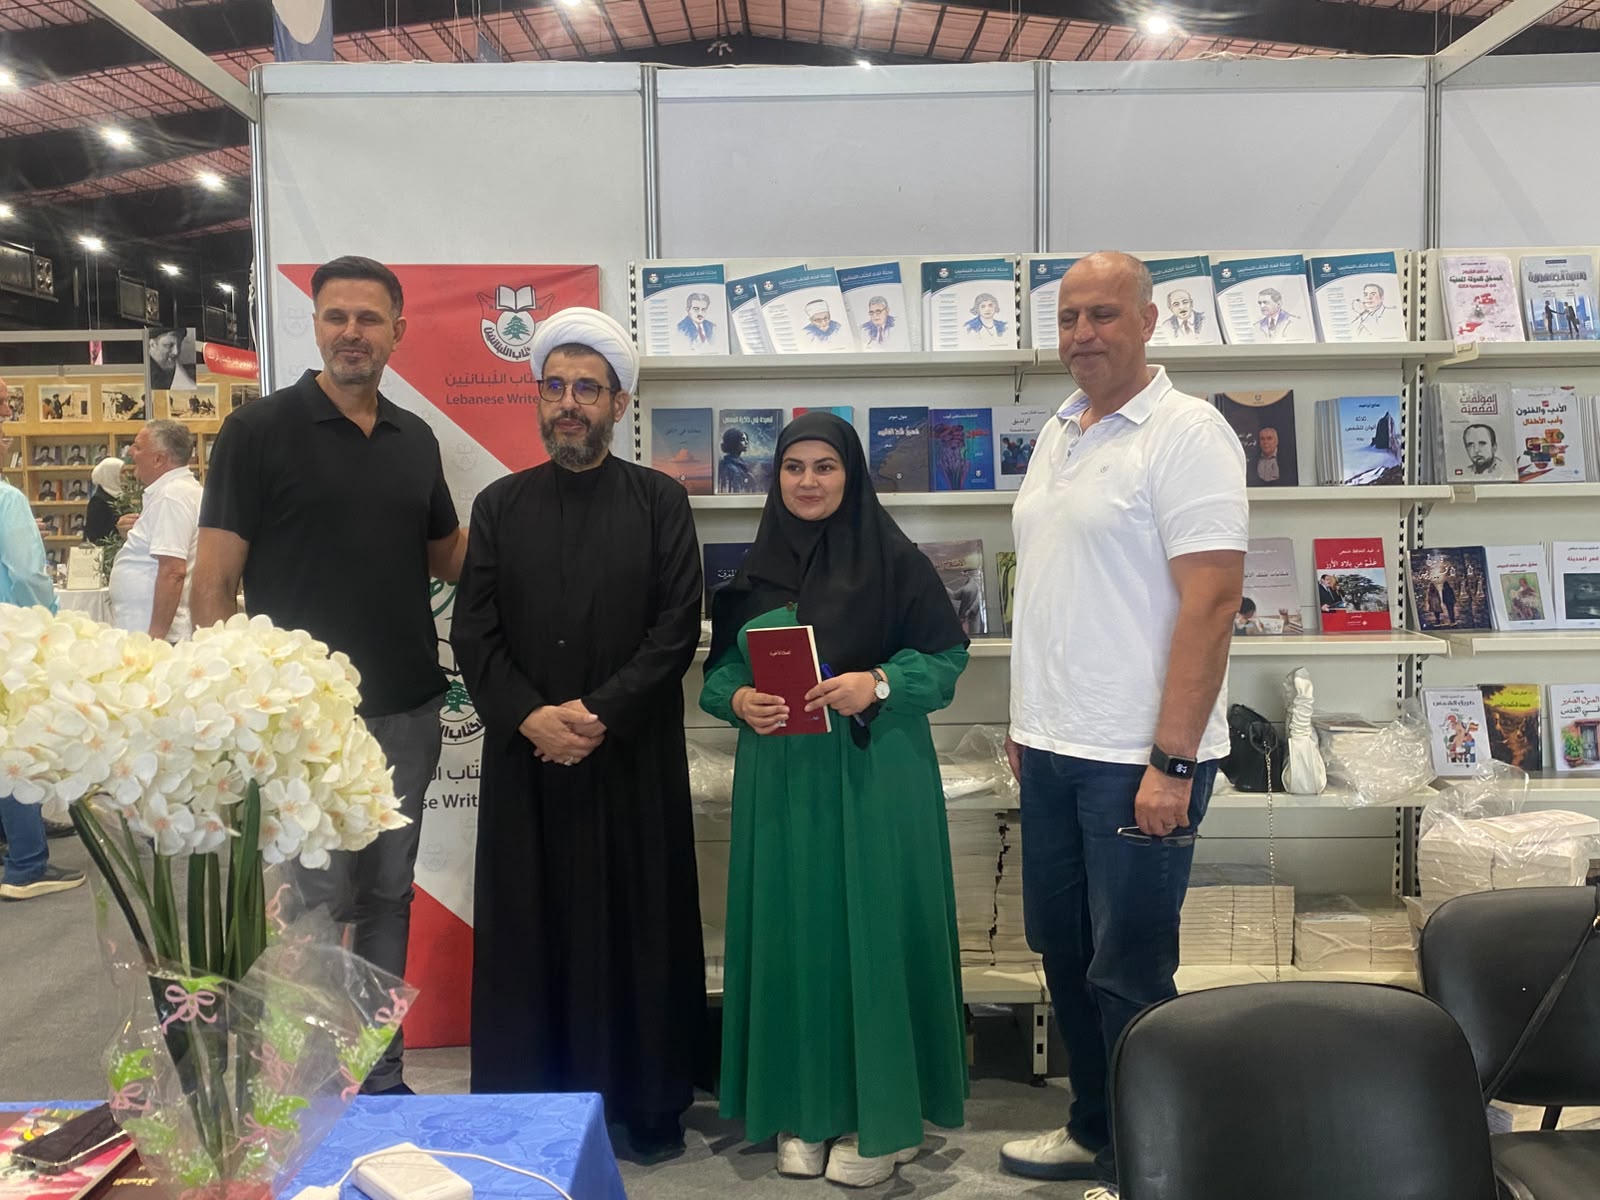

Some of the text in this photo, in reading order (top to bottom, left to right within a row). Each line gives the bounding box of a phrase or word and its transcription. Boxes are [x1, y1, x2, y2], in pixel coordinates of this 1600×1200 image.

[445, 392, 539, 405] Lebanese Write
[1560, 705, 1582, 716] القدس
[442, 793, 480, 808] Writ
